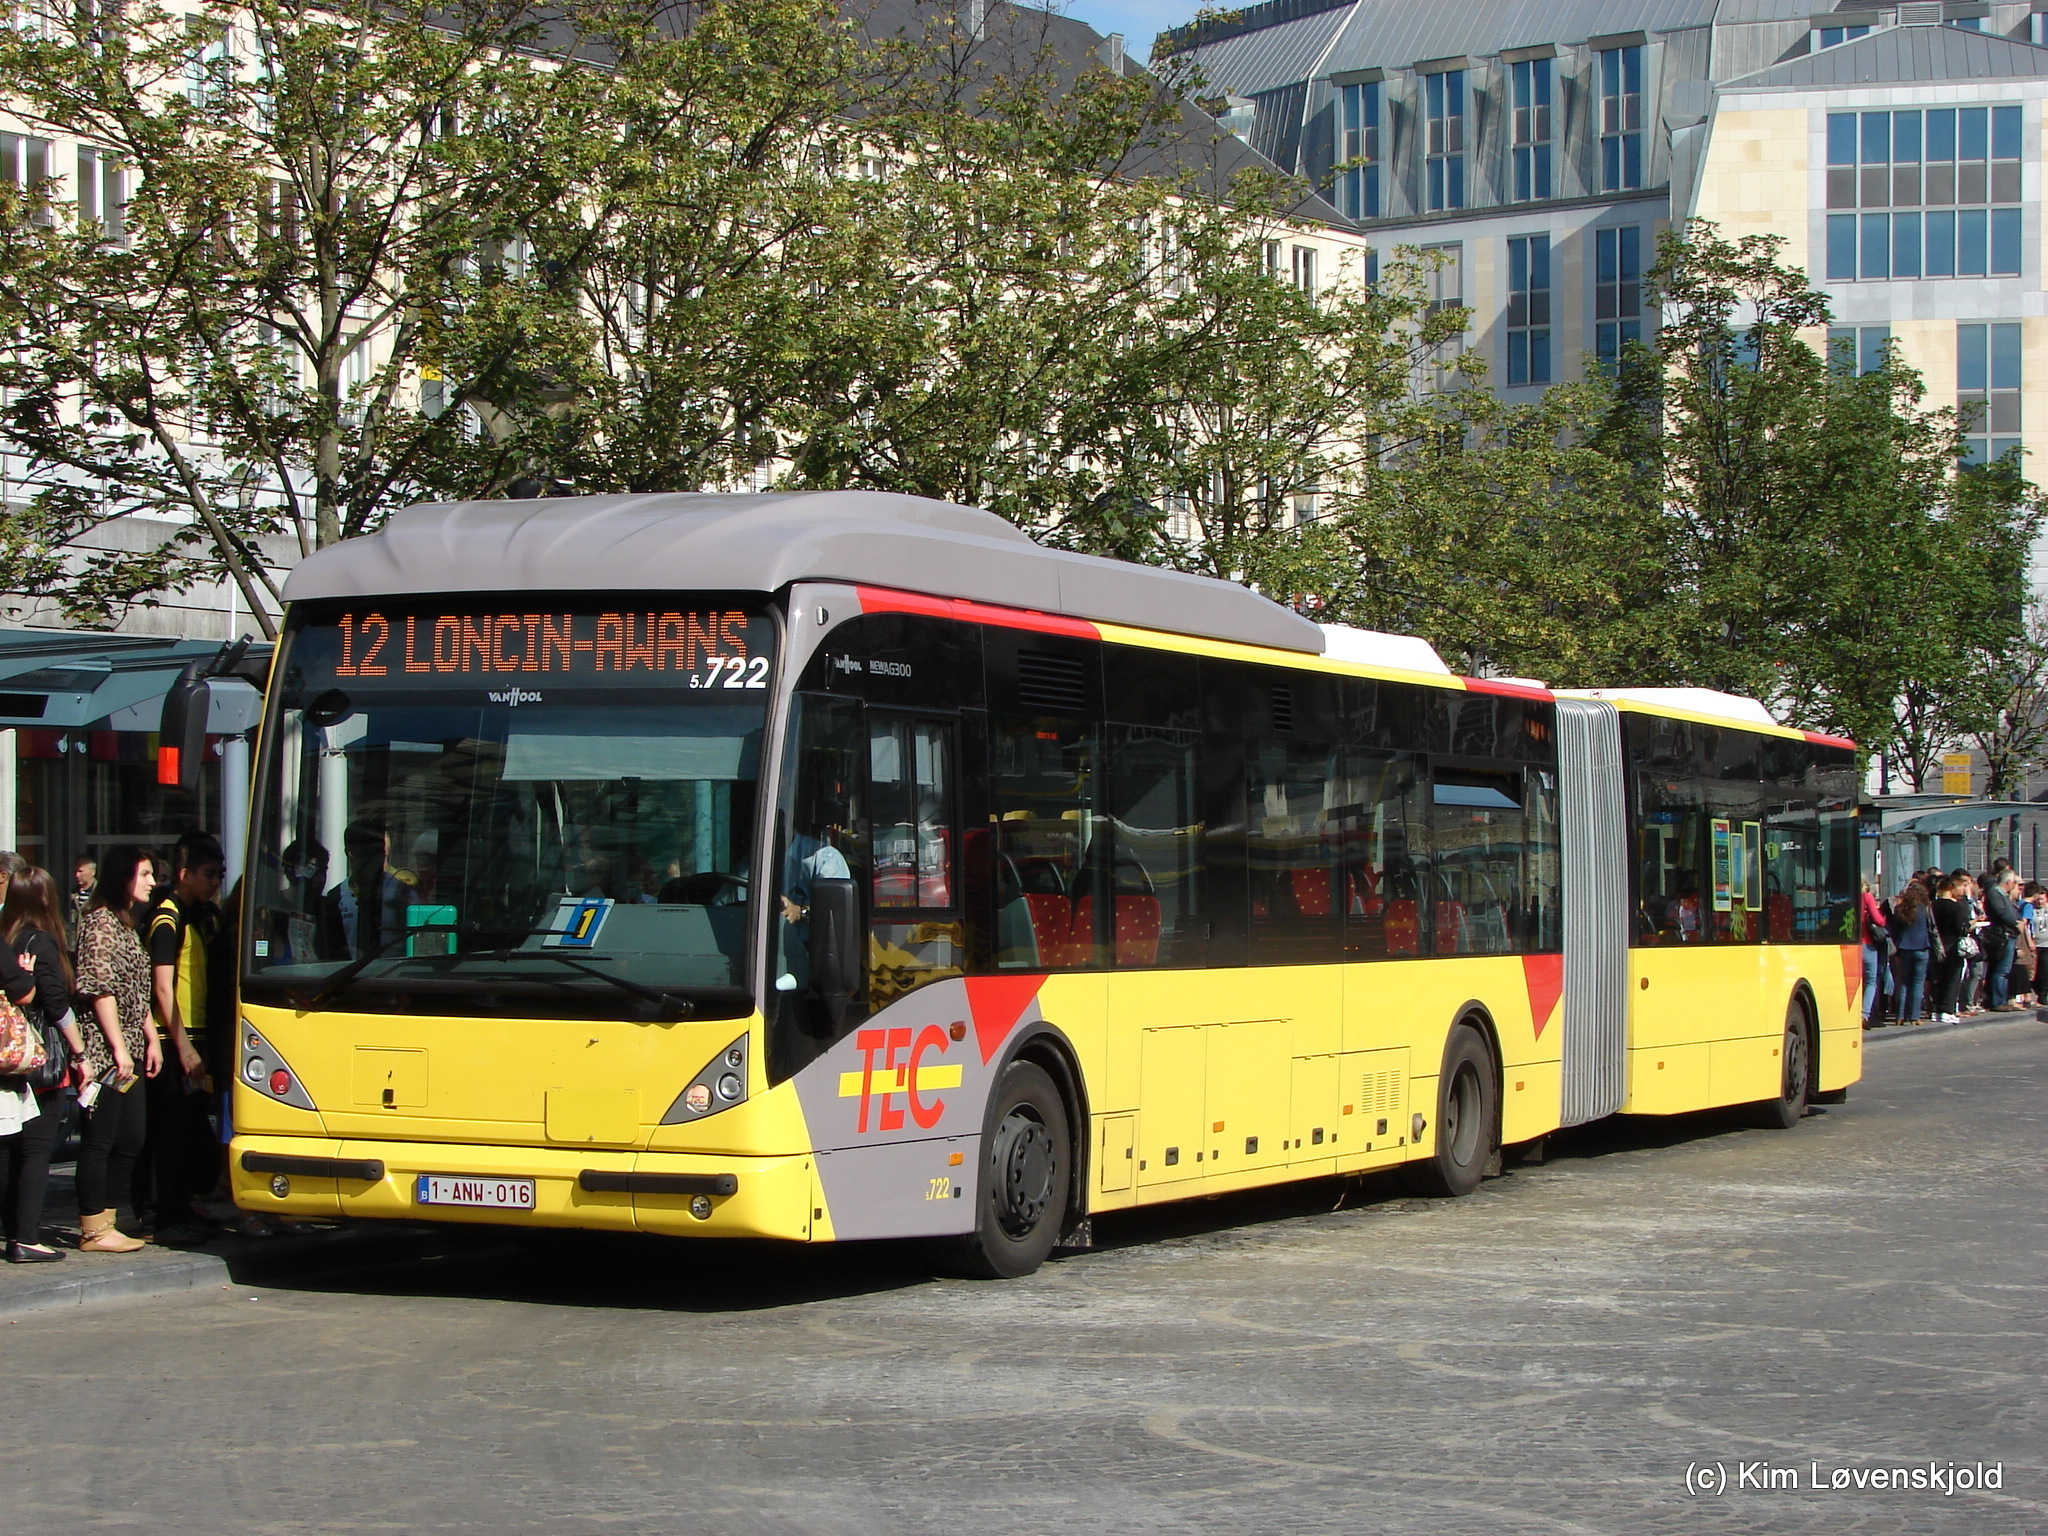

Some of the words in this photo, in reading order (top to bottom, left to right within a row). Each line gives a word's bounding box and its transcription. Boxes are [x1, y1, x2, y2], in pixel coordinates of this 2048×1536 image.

[336, 613, 389, 676] 12
[405, 611, 747, 671] LONCIN-AWANS
[689, 656, 769, 688] 5.722
[576, 908, 597, 938] 1
[855, 1024, 949, 1134] TEC
